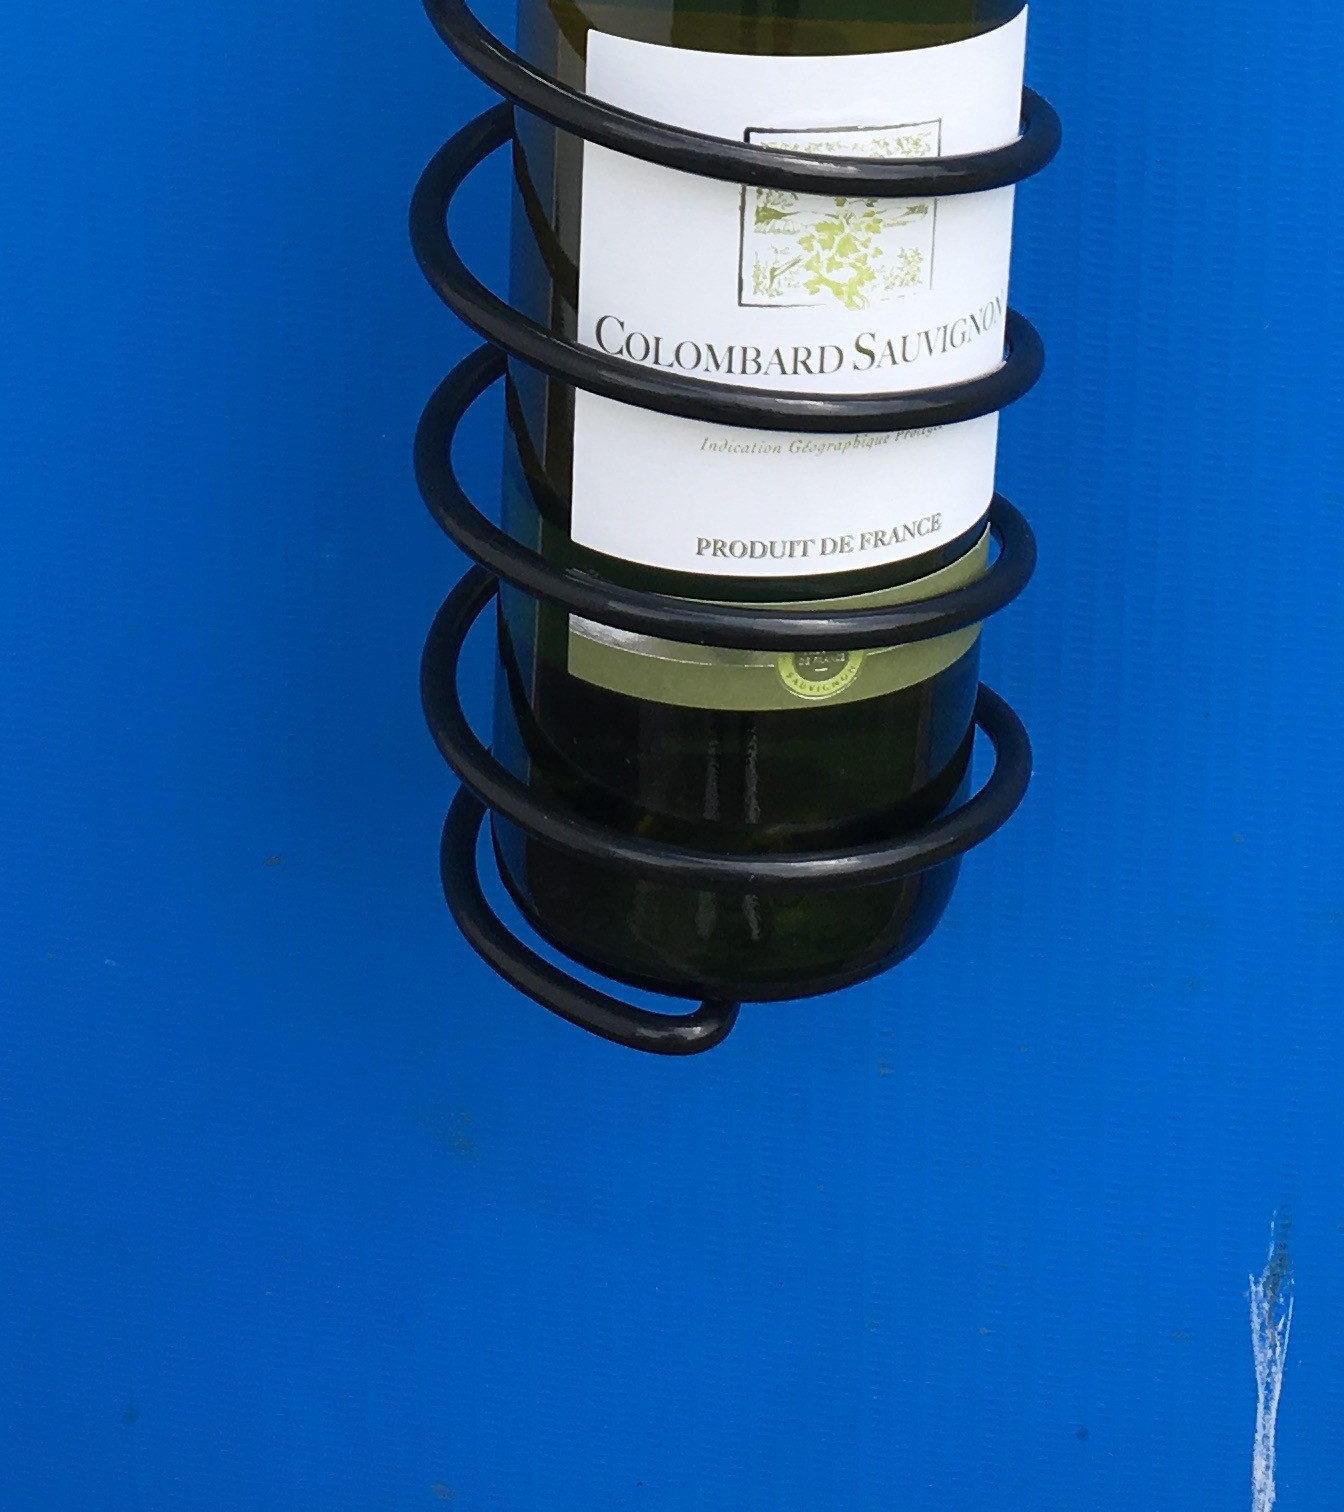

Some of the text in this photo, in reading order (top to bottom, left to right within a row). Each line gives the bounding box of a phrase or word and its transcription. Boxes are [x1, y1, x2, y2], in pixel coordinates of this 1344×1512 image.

[595, 289, 1004, 376] COLOMBARD SAUVIGNON
[700, 437, 782, 454] Indication
[696, 512, 942, 559] PRODUIT DE FRANCE
